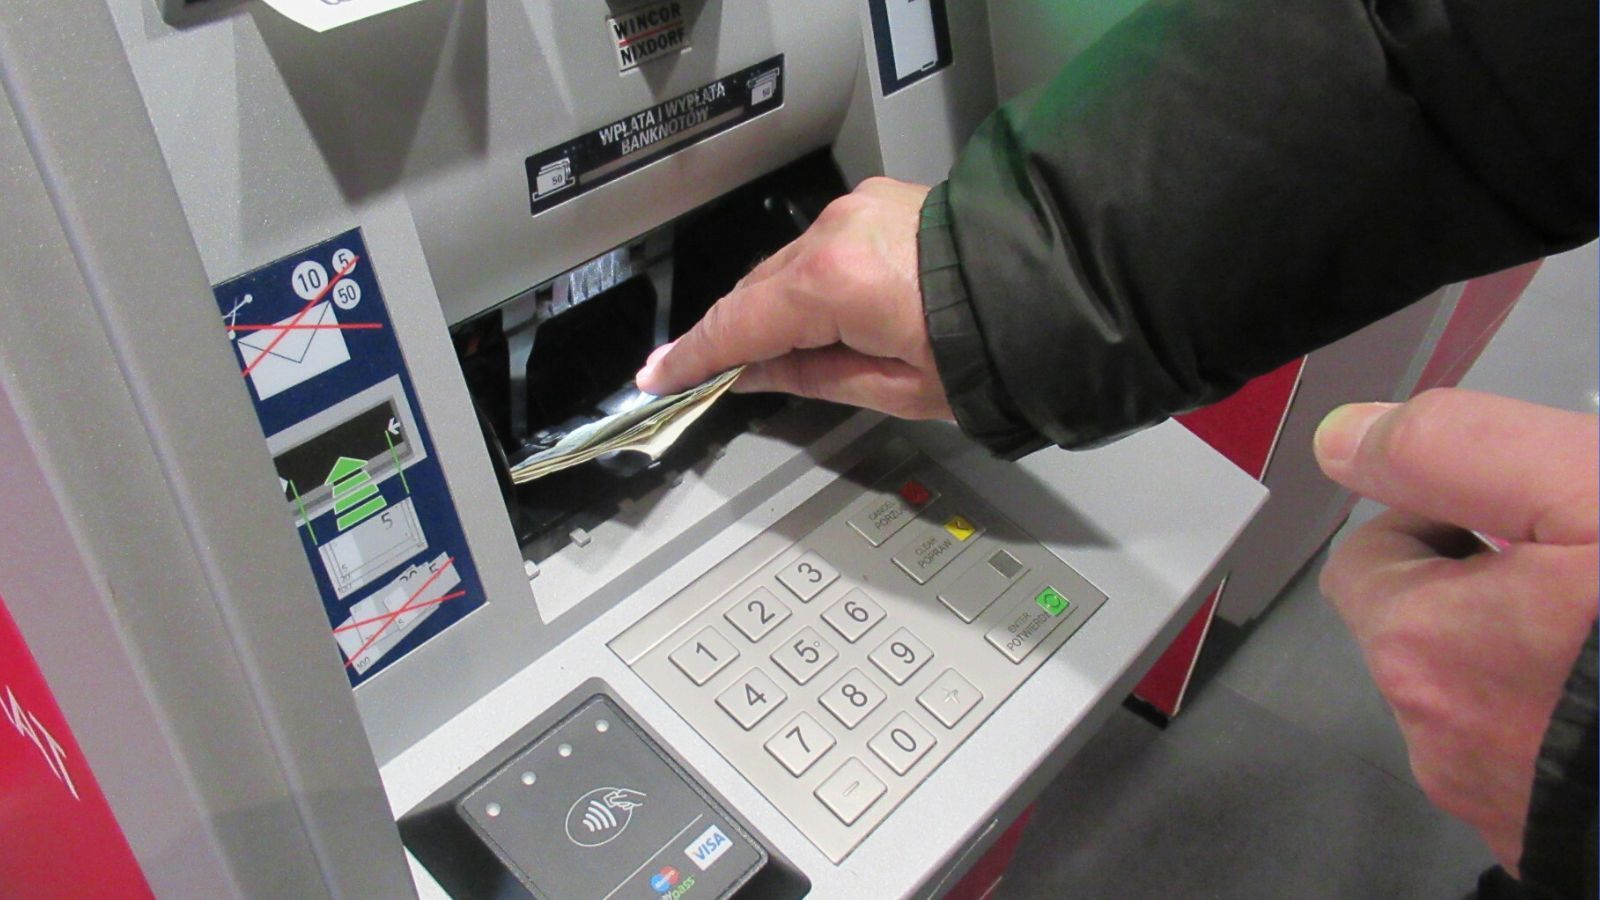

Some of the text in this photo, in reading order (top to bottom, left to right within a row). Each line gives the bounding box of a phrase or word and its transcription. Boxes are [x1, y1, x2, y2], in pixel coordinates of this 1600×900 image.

[613, 2, 681, 40] WINCOR
[620, 27, 685, 66] NIXDORF
[599, 81, 727, 146] WPŁATA I WYPŁATA
[621, 105, 709, 155] BANKNOTÓW
[552, 174, 563, 186] 50
[338, 253, 351, 271] 5
[298, 268, 321, 293] 10
[338, 284, 357, 304] 50
[381, 511, 394, 530] 5
[918, 539, 952, 568] POPRAW
[797, 562, 823, 584] 3
[747, 600, 776, 625] 2
[844, 600, 869, 623] 6
[1007, 612, 1031, 634] ENTER
[695, 641, 718, 663] 1
[793, 638, 820, 664] 5
[890, 641, 916, 664] 9
[744, 683, 767, 707] 4
[841, 683, 868, 707] 8
[785, 726, 811, 753] 7
[890, 728, 917, 752] 0
[695, 831, 726, 860] VISA
